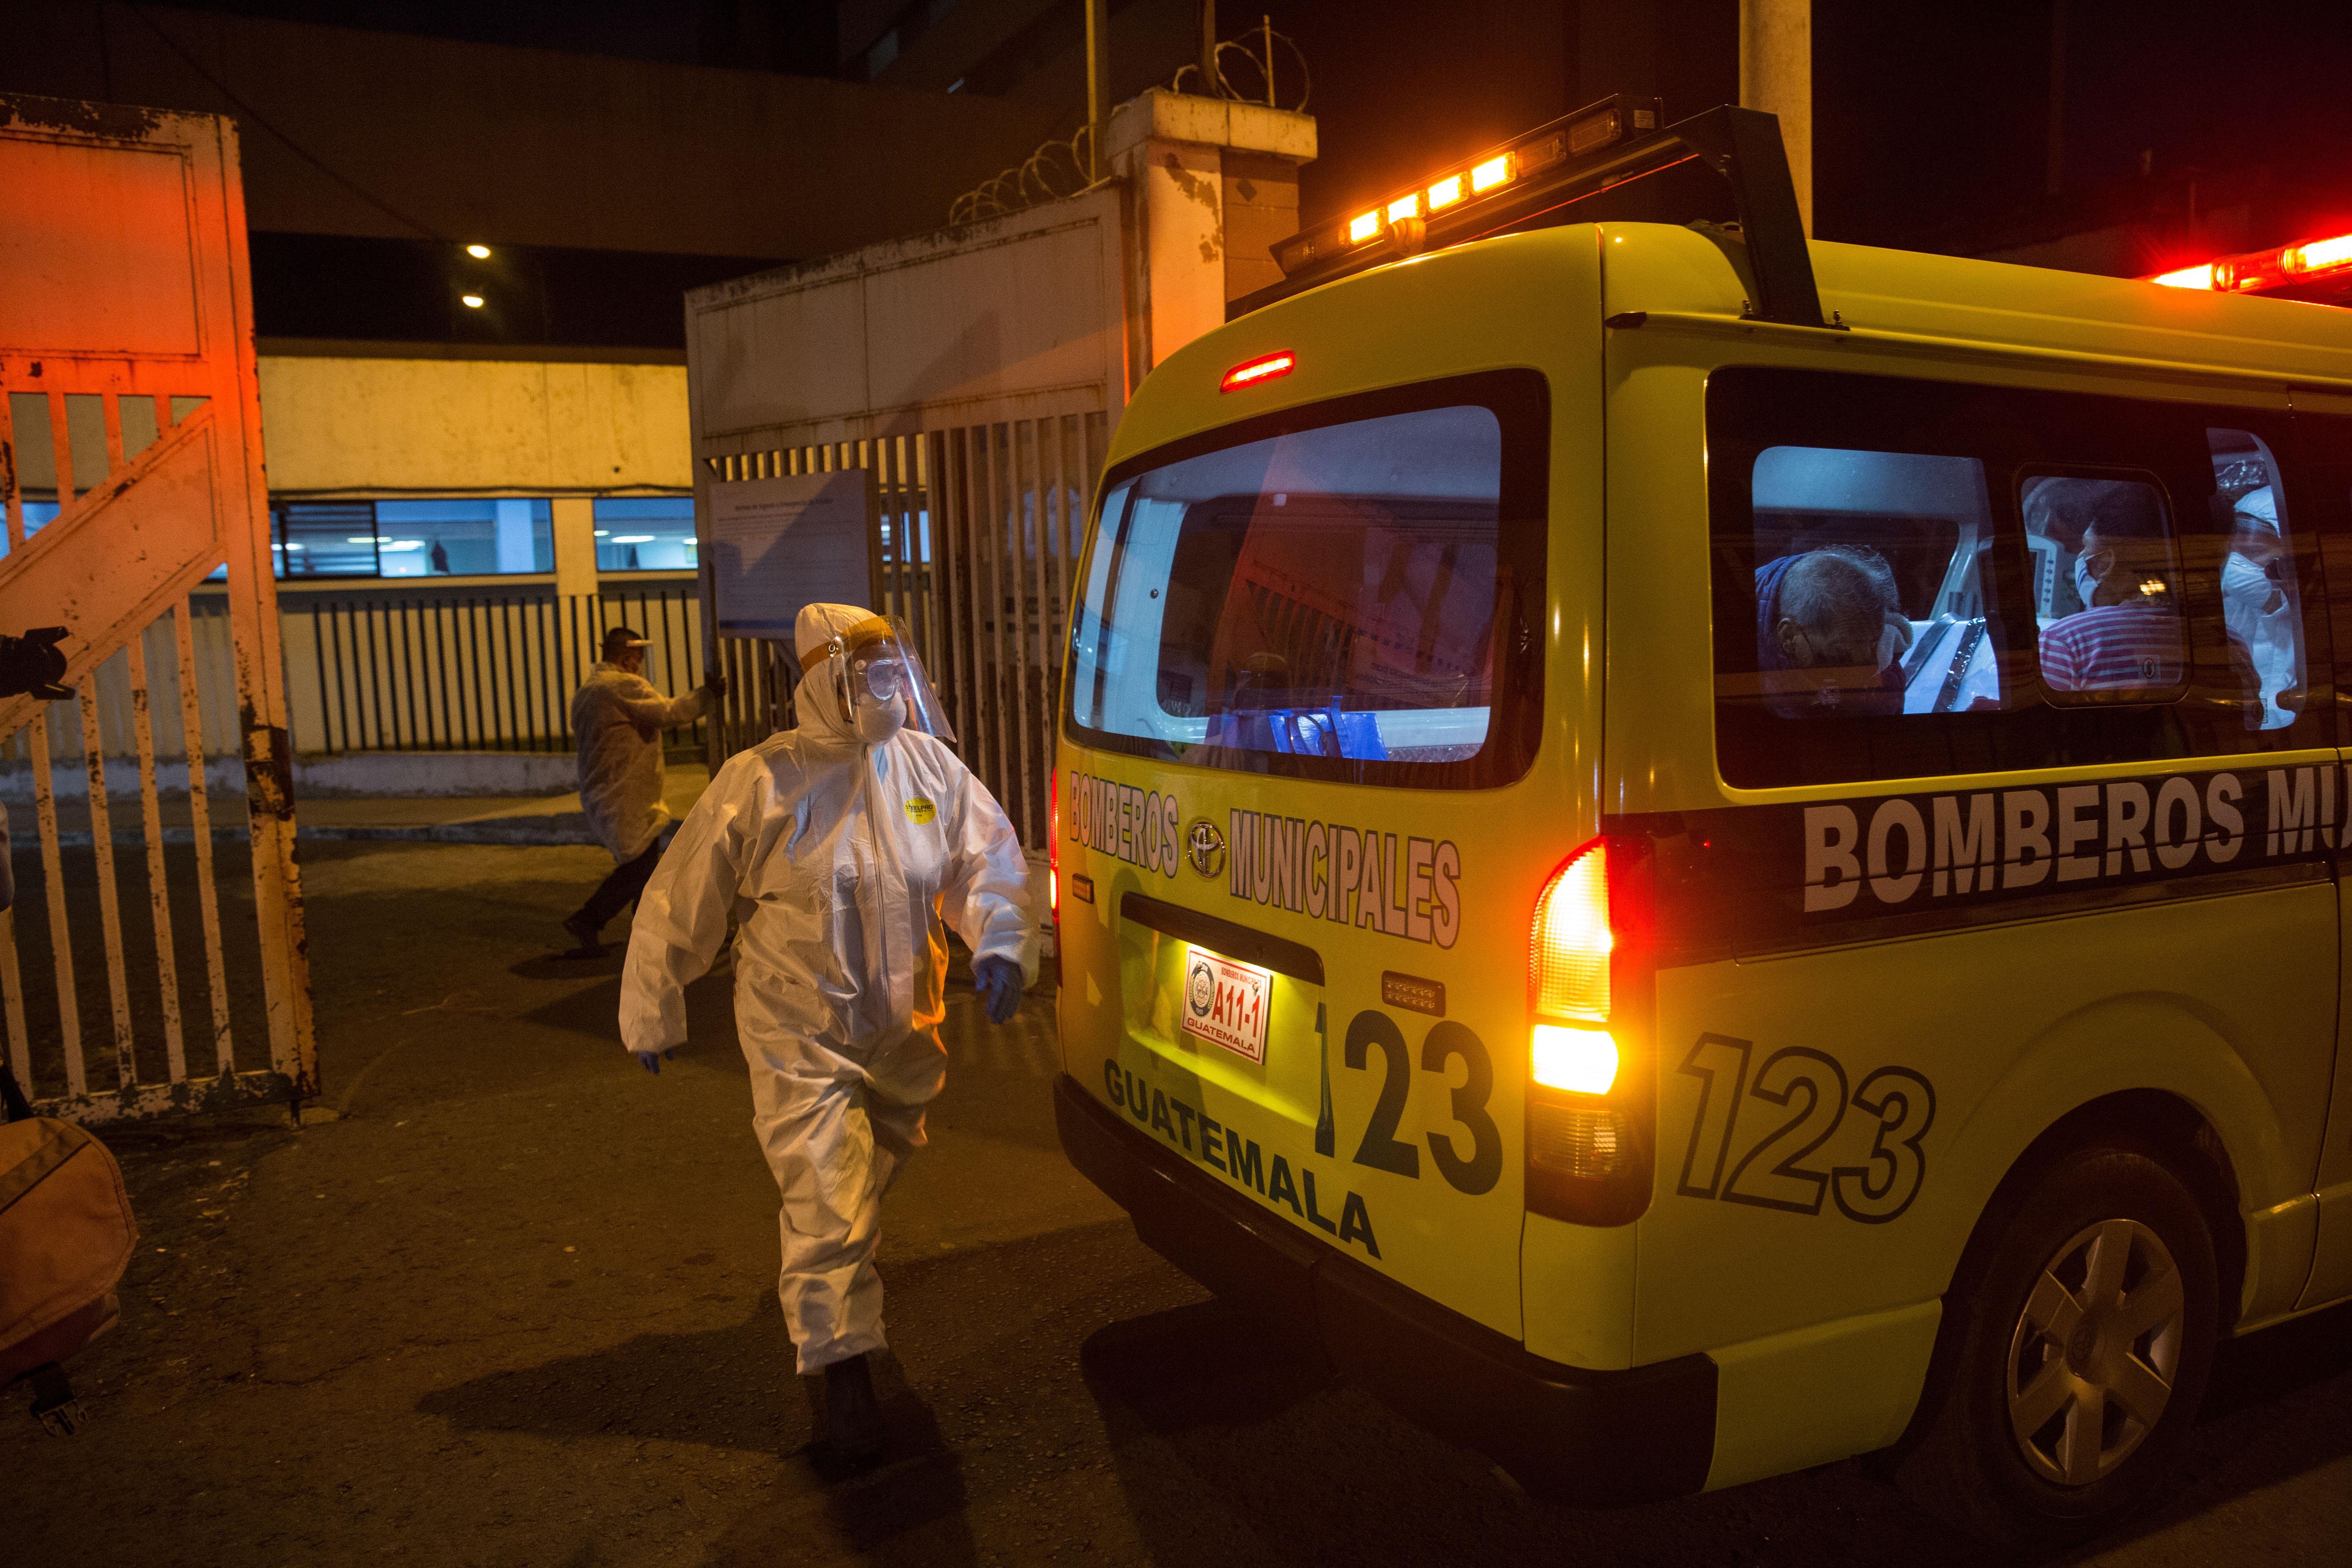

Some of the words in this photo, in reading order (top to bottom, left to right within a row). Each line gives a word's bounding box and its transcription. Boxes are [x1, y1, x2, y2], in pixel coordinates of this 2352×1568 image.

[1070, 770, 1179, 878] BOMBEROS
[1230, 807, 1461, 949] MUNICIPALES
[1804, 773, 2244, 912] BOMBEROS
[1187, 1017, 1255, 1053] GUATEMALA
[1212, 981, 1260, 1038] A11-1
[1315, 1002, 1503, 1196] 123
[1104, 1058, 1382, 1261] GUATEMALA
[1675, 1031, 1936, 1225] 123
